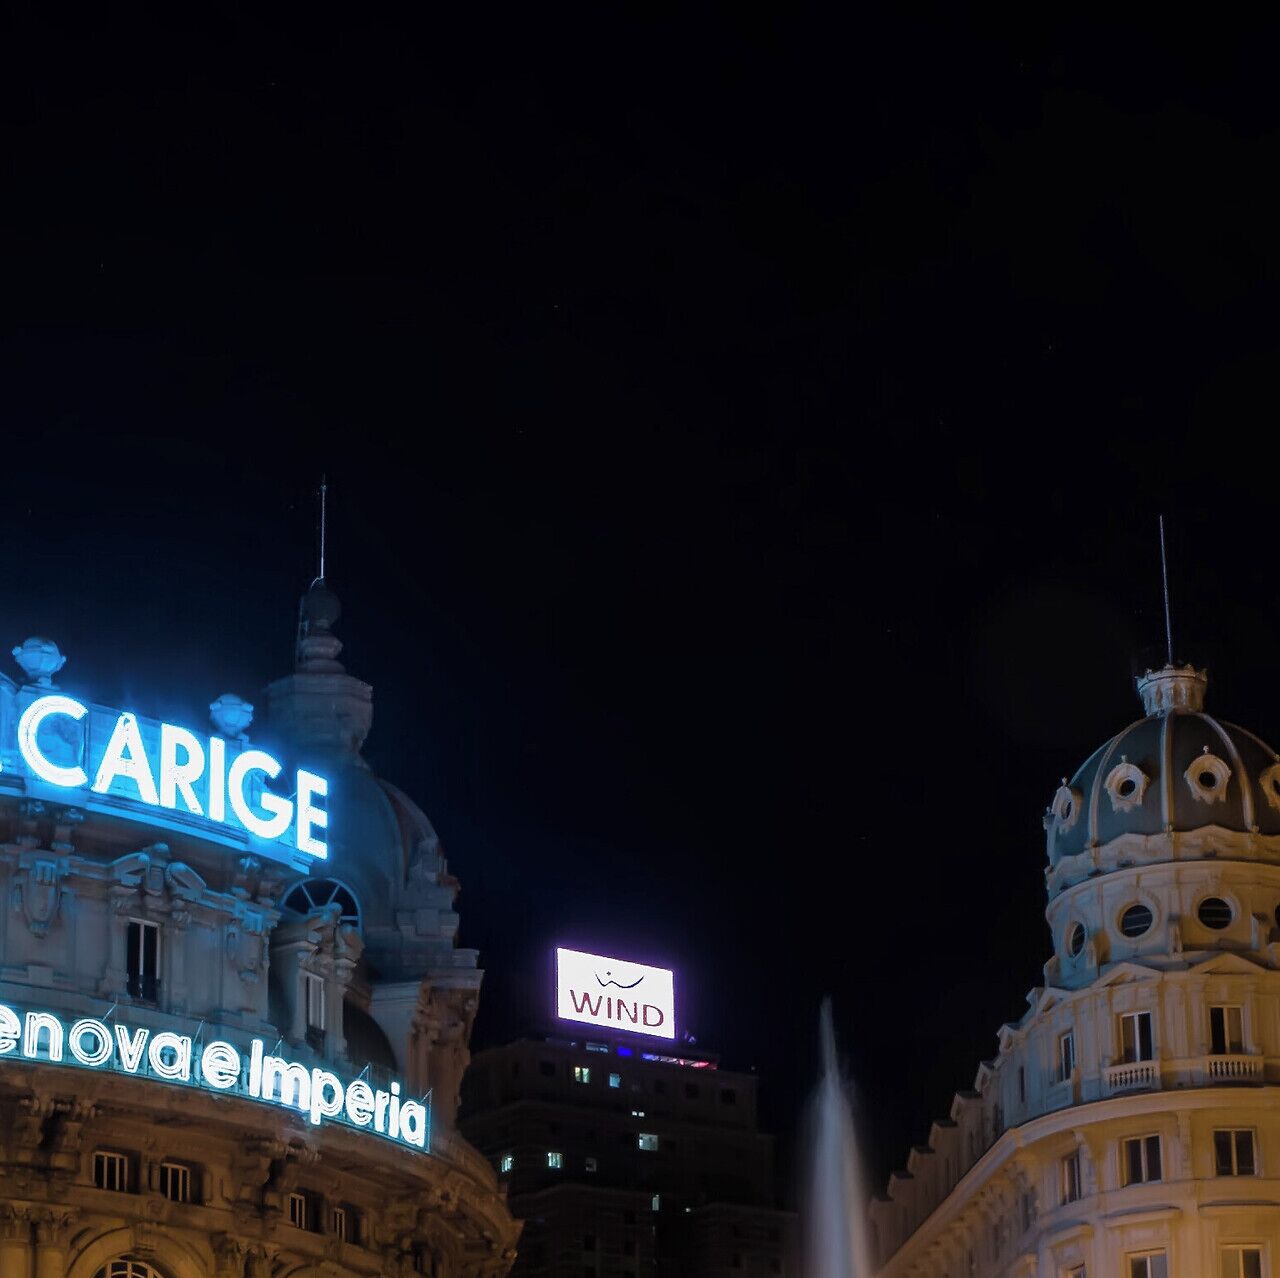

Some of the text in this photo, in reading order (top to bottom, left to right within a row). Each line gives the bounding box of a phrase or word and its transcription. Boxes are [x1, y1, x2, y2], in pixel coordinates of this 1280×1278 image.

[18, 695, 327, 859] CARIGE
[569, 989, 664, 1027] WIND
[201, 1041, 241, 1089] e
[249, 1038, 426, 1147] Imperia
